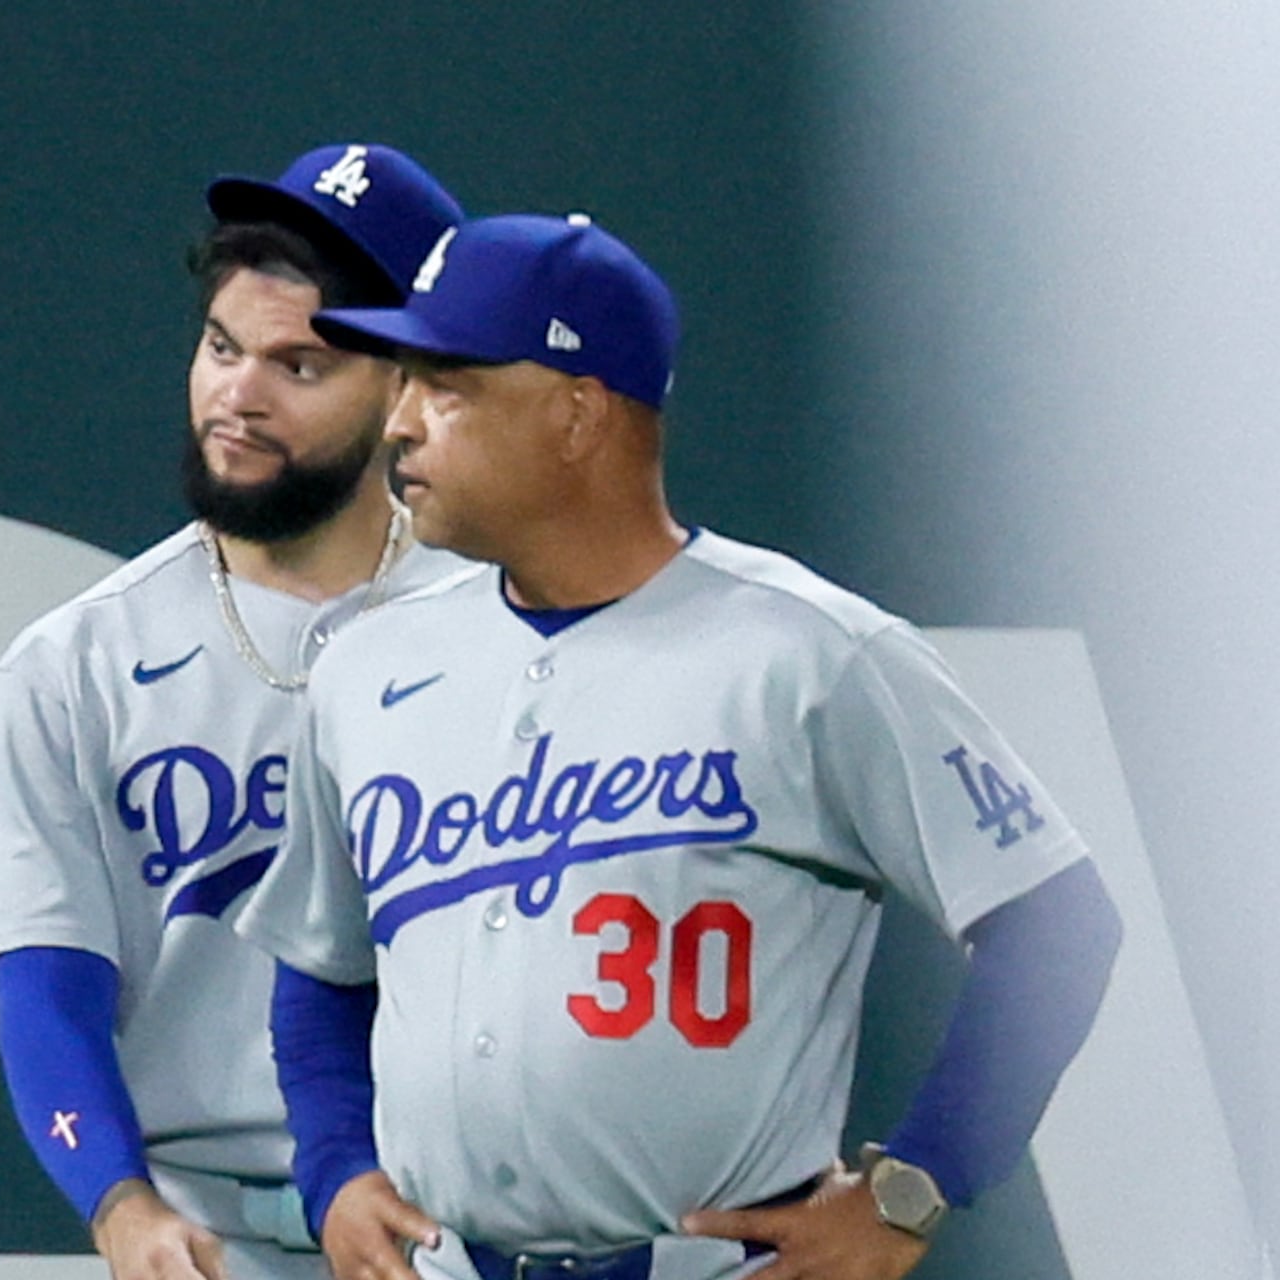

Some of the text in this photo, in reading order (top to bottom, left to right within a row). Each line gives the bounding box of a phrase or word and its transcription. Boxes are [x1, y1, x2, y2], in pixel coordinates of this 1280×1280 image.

[314, 144, 371, 208] LA
[345, 730, 758, 951] Dodgers
[941, 746, 1045, 850] LA
[567, 892, 753, 1049] 30
